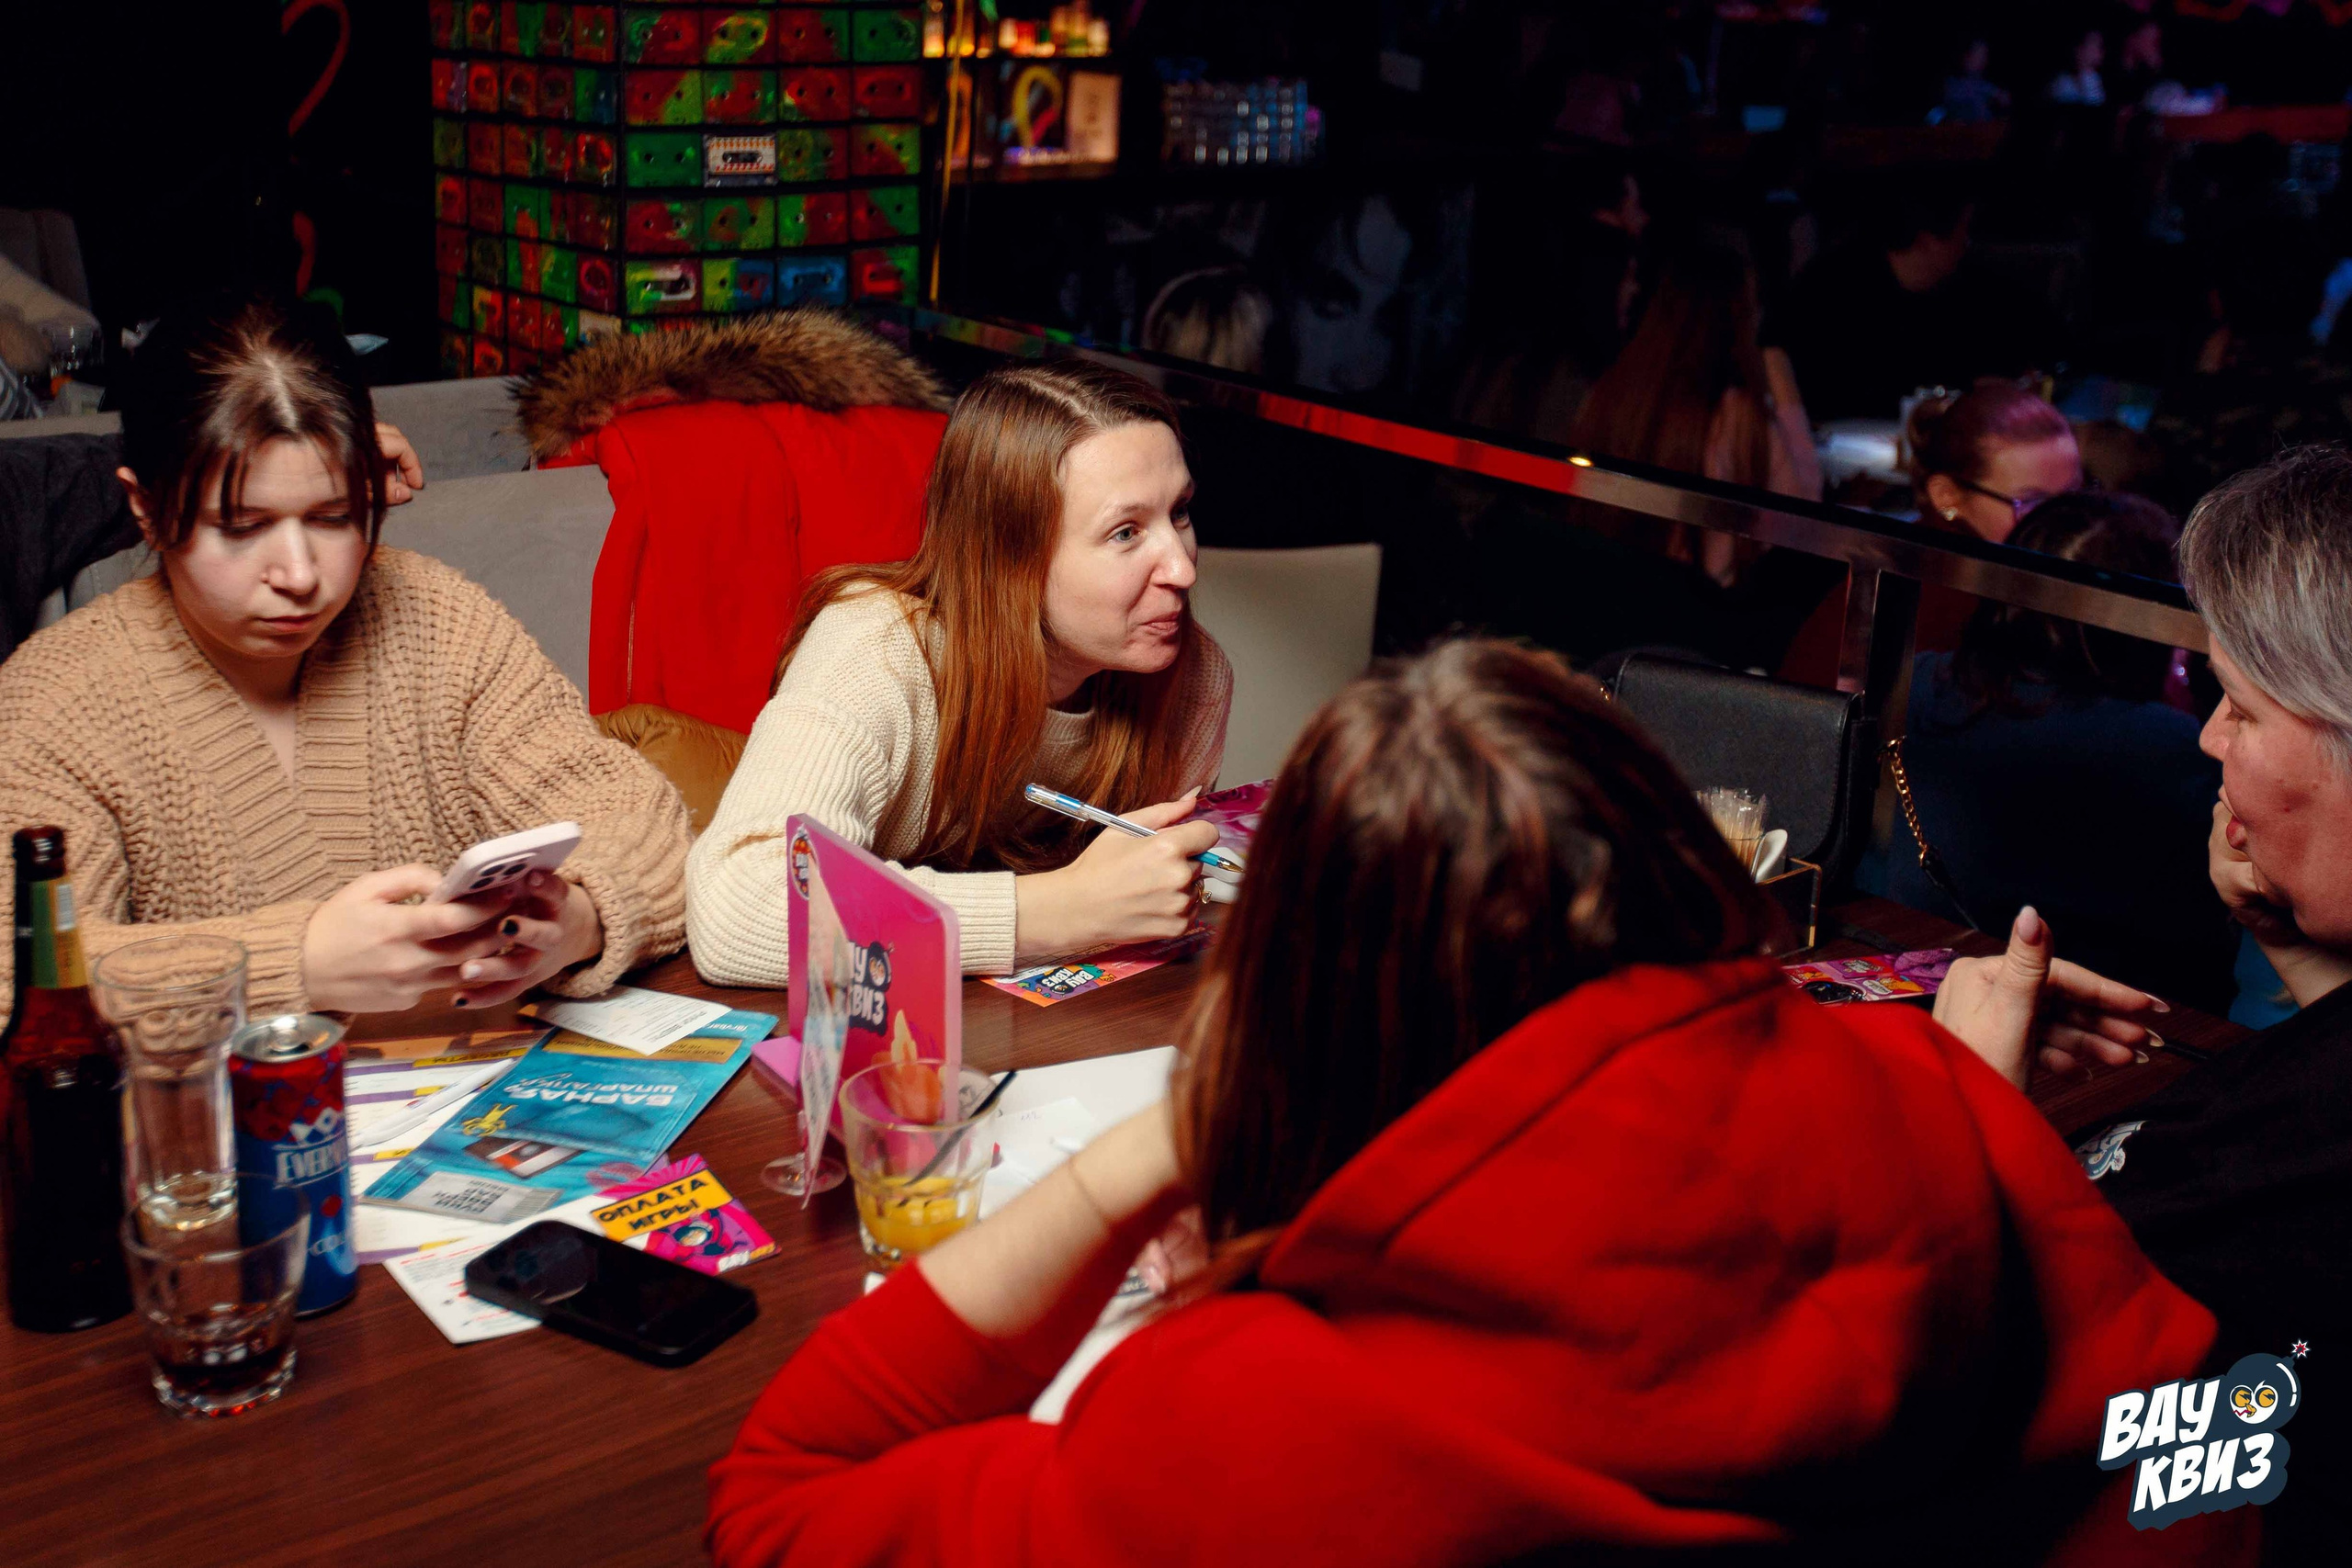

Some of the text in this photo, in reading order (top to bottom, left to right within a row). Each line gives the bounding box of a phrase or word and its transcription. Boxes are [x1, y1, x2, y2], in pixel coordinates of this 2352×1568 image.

[1042, 968, 1073, 987] КВИЗ
[1066, 970, 1094, 987] ВАУ
[850, 986, 885, 1026] ВИЗ
[517, 1075, 679, 1094] ШПАРГАЛКА
[505, 1087, 675, 1107] БАРНАЯ
[599, 1179, 707, 1222] ОПЛАТА
[628, 1200, 700, 1230] ИГРЫ
